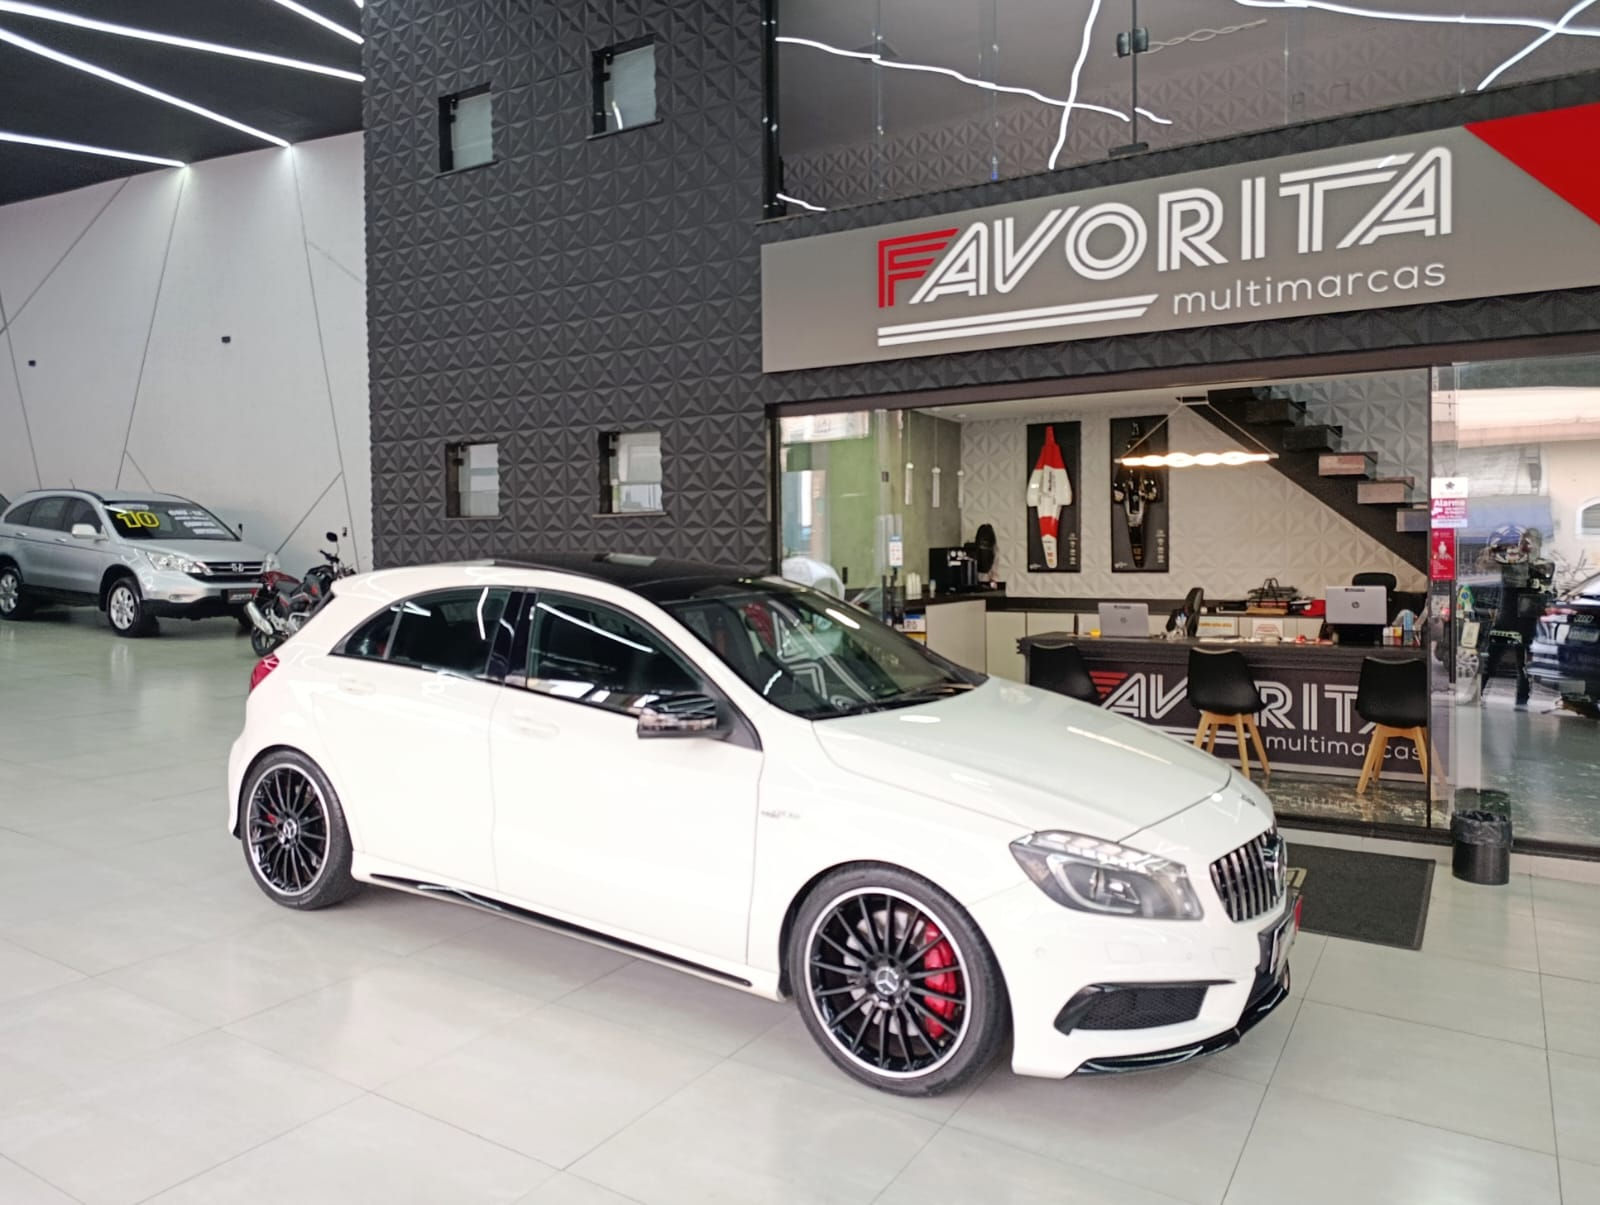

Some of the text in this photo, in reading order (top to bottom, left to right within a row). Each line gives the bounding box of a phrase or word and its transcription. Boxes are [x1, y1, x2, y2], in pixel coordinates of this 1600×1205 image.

[878, 146, 1452, 308] FAVORITA
[1173, 263, 1446, 315] multimarcas
[1265, 734, 1421, 761] multimacas
